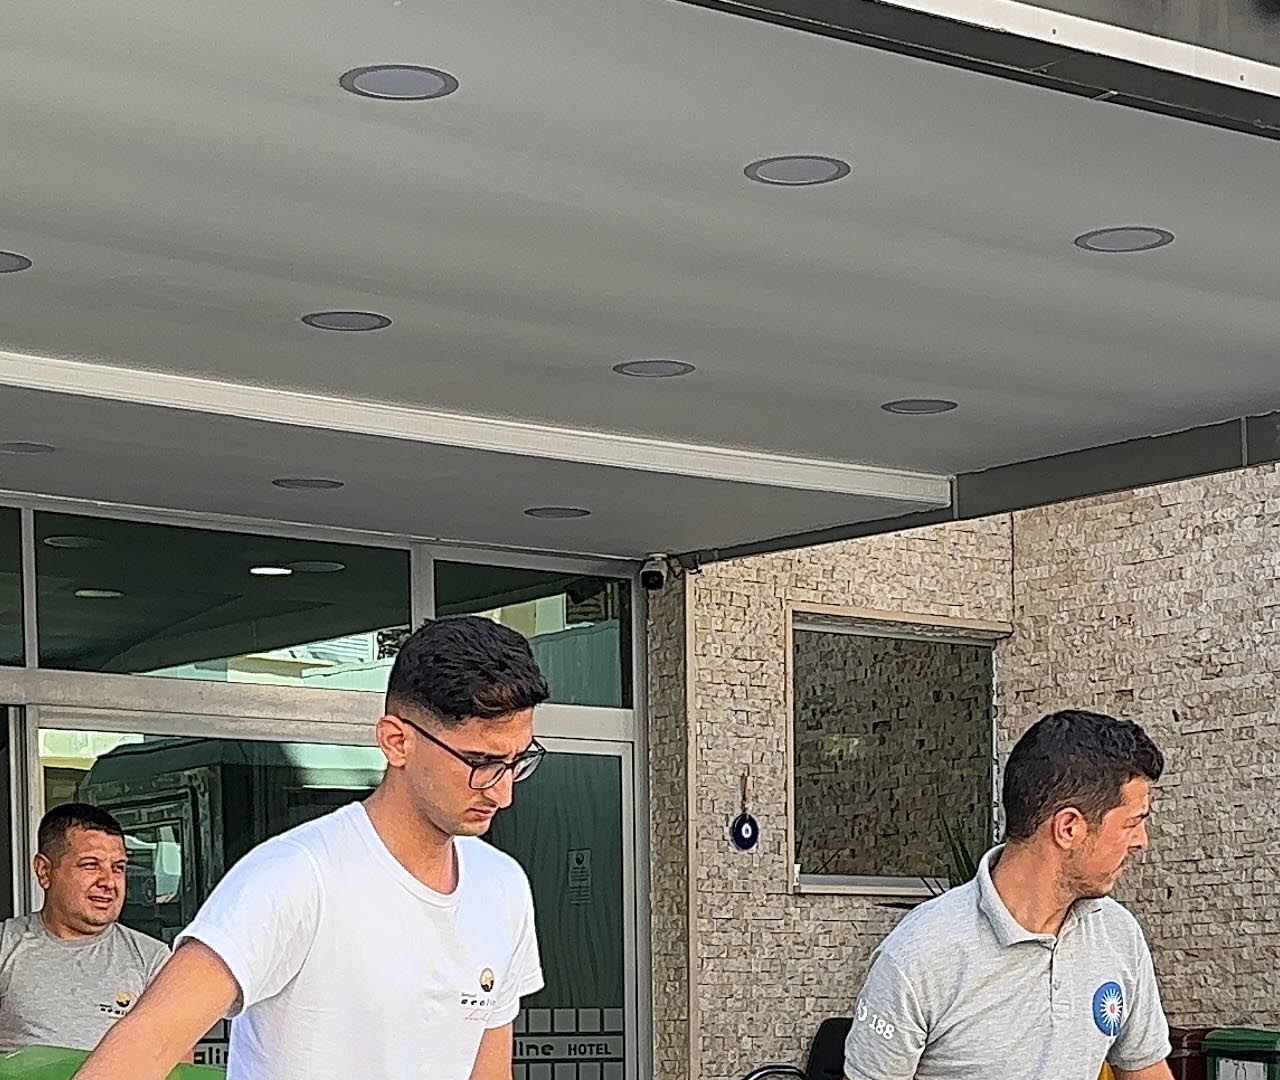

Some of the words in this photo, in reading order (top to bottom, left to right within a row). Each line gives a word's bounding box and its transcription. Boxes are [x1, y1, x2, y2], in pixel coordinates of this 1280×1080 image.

[869, 1013, 895, 1040] 188
[512, 1040, 555, 1057] line
[567, 1043, 612, 1056] HOTEL
